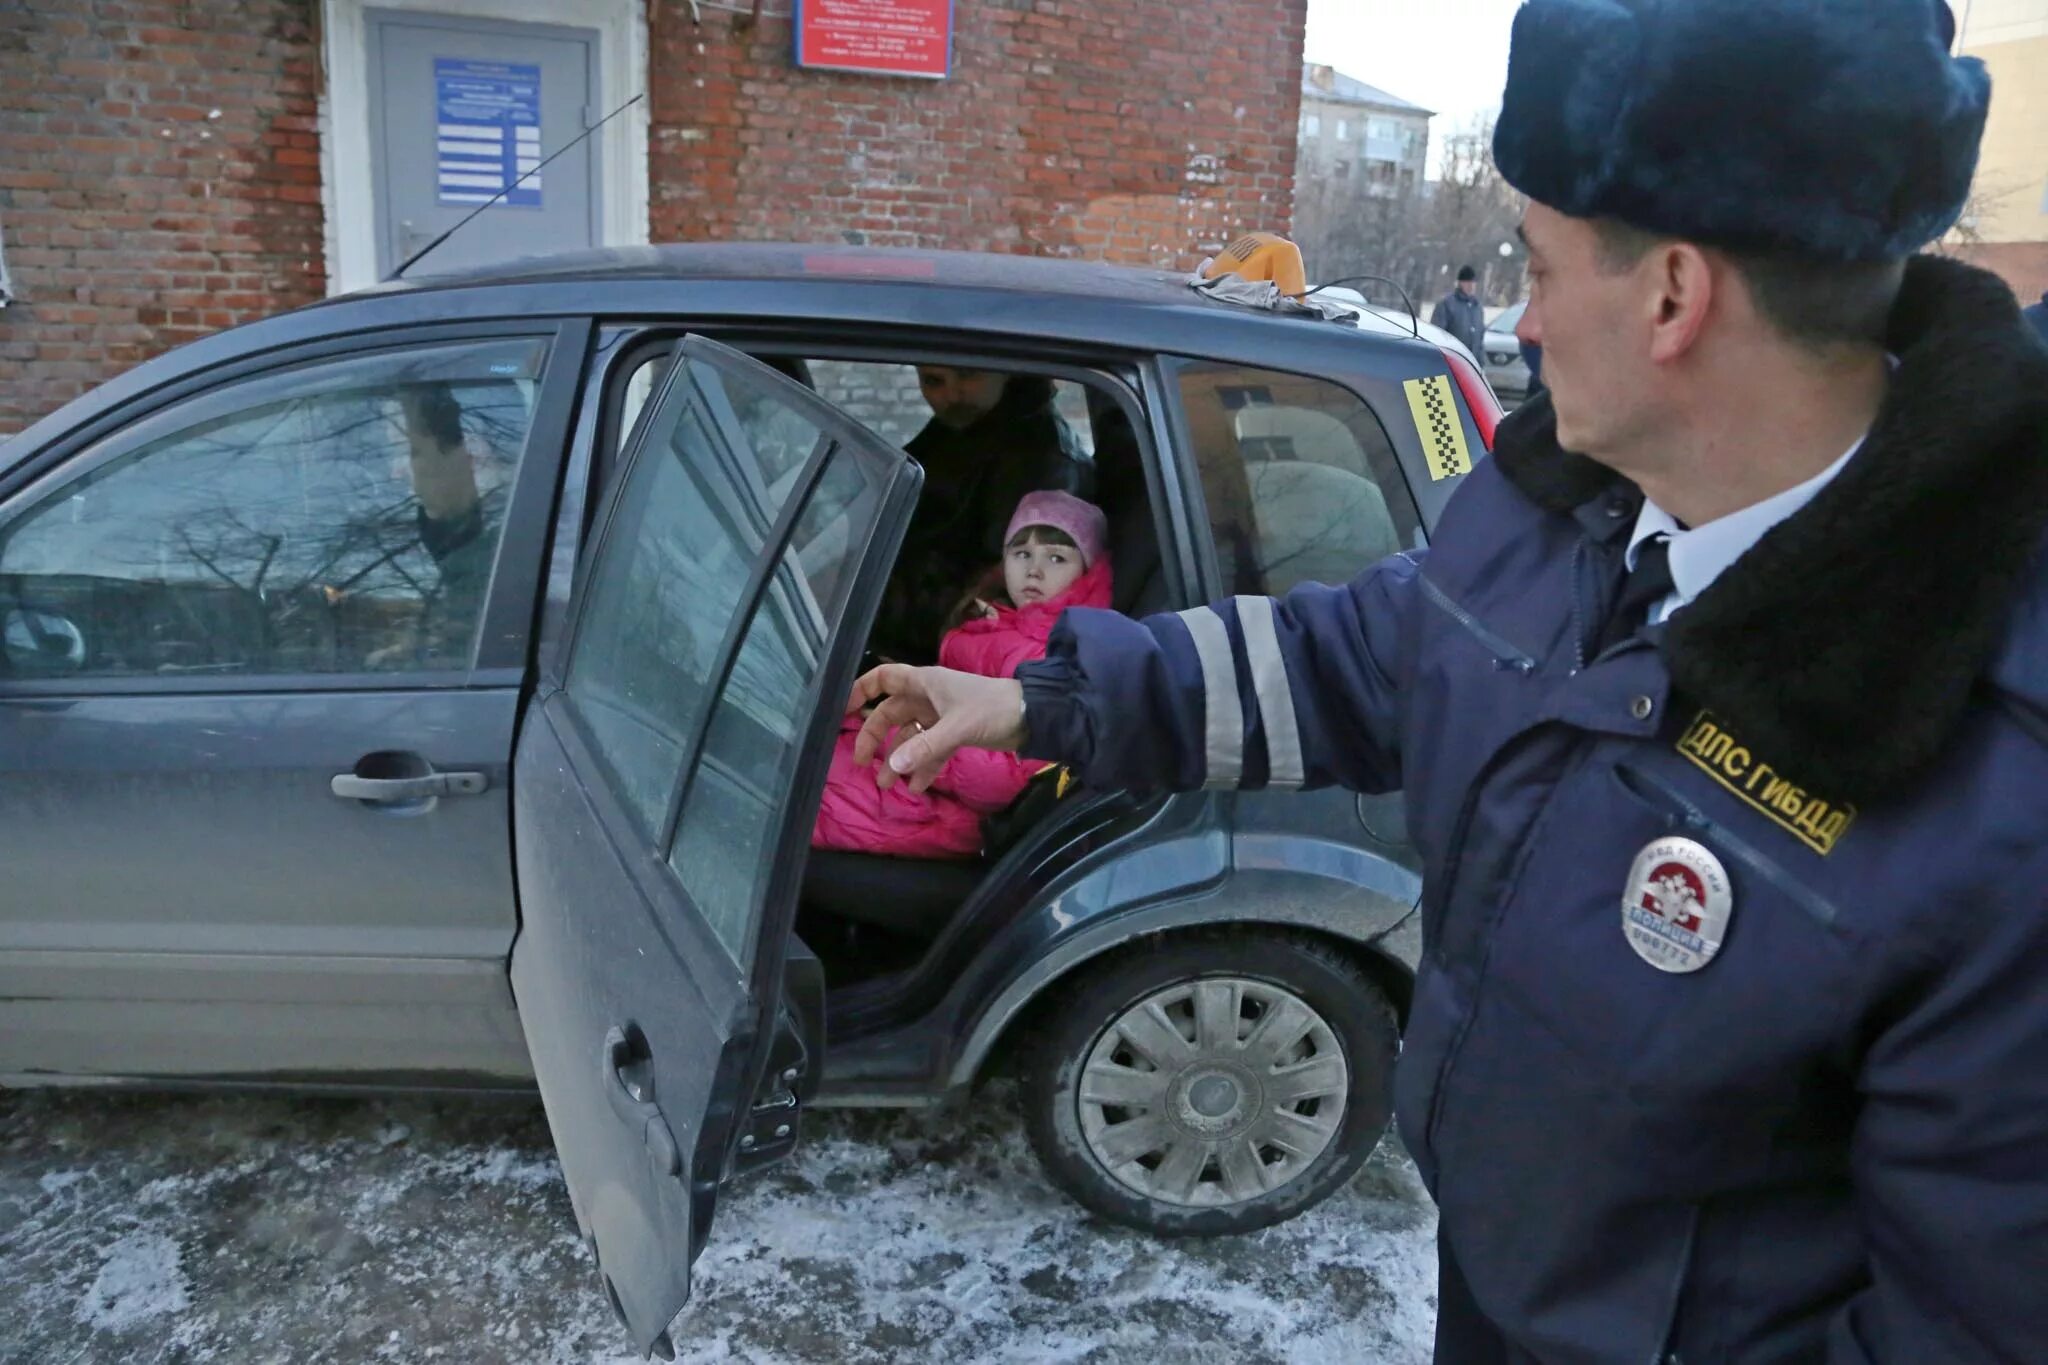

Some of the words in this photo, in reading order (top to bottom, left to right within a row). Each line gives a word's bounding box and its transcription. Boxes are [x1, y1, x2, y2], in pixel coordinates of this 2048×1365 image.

[1687, 721, 1751, 777] ДПС
[1745, 763, 1848, 848] ГИБДД
[1632, 907, 1703, 952] ПОЛИЦИЯ
